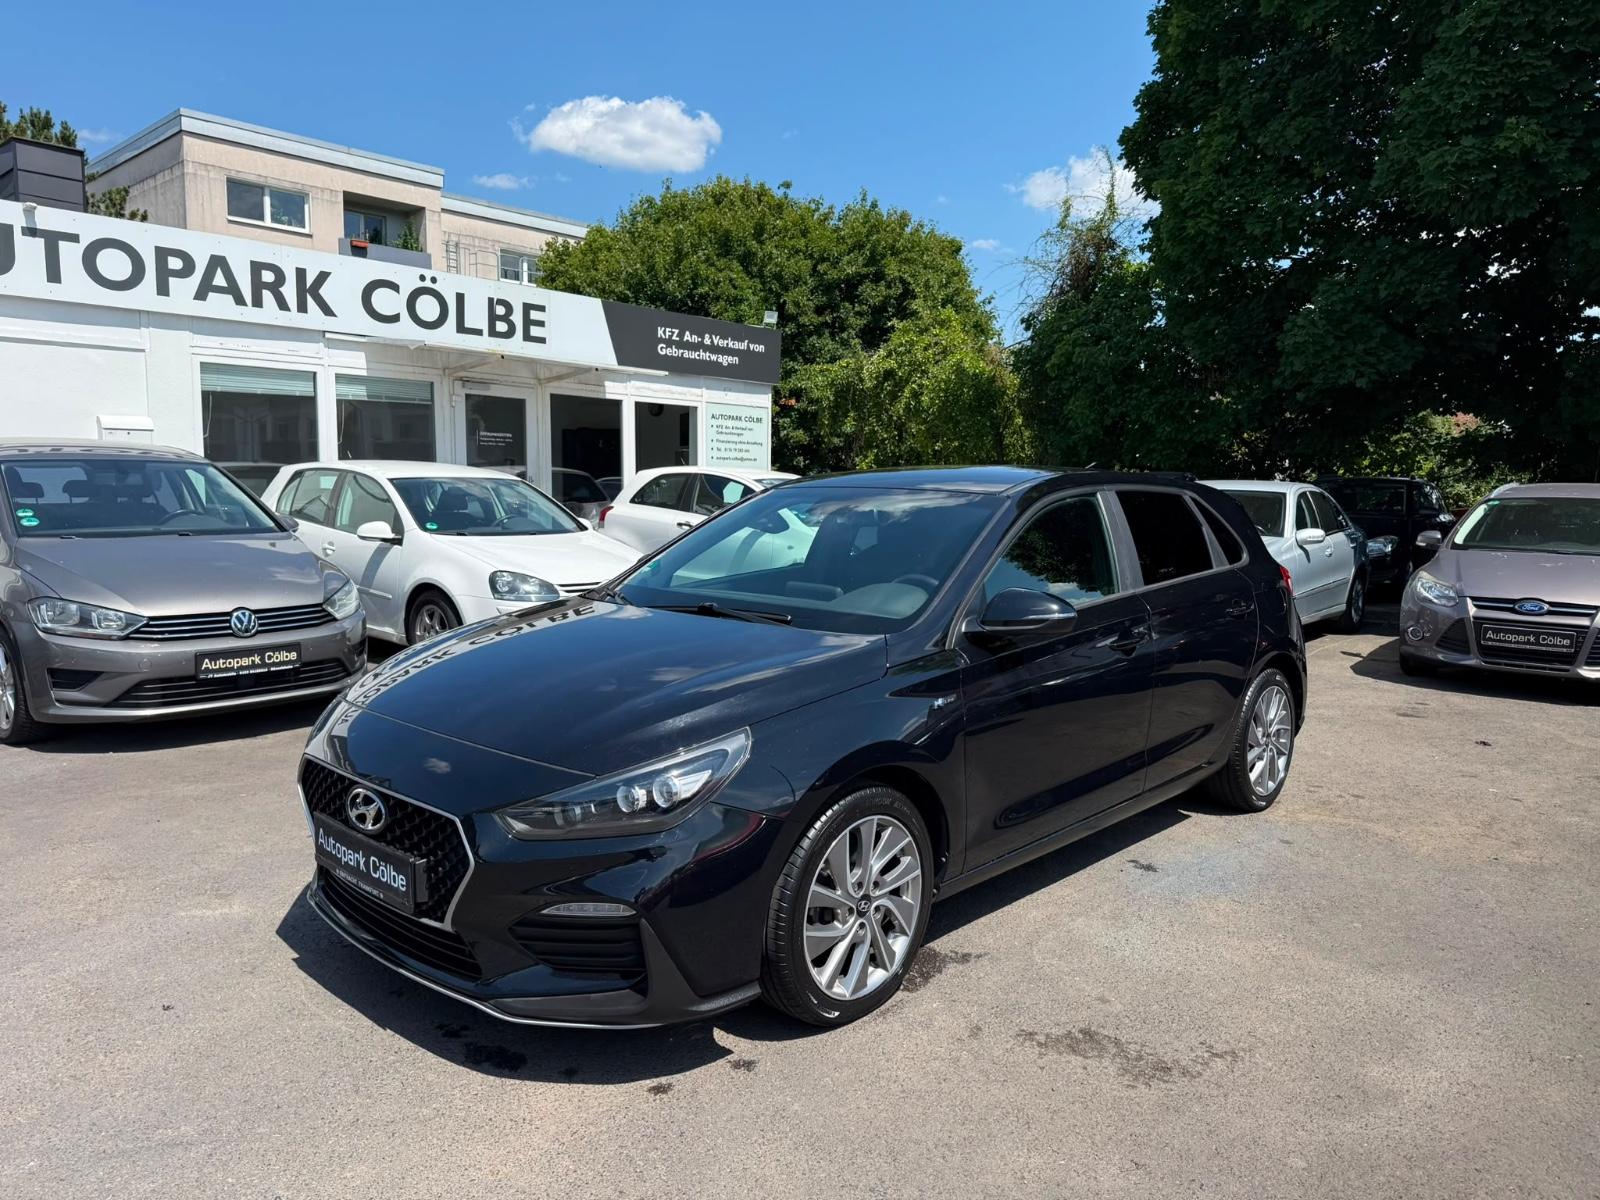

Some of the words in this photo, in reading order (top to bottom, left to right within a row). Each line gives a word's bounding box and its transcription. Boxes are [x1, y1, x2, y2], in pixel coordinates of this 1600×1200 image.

[361, 274, 547, 345] CÖLBE
[657, 326, 680, 341] KFZ
[684, 331, 702, 343] An-
[704, 333, 711, 346] &
[712, 334, 749, 350] Verkauf
[749, 342, 765, 353] von
[657, 343, 739, 366] Gebrauchtwagen
[711, 413, 743, 422] AUTOPARK
[1485, 630, 1536, 643] Autopark
[201, 653, 262, 670] Autopark
[265, 650, 297, 664] Cölbe
[318, 828, 367, 873] Autopark
[369, 856, 407, 892] Cölbe
